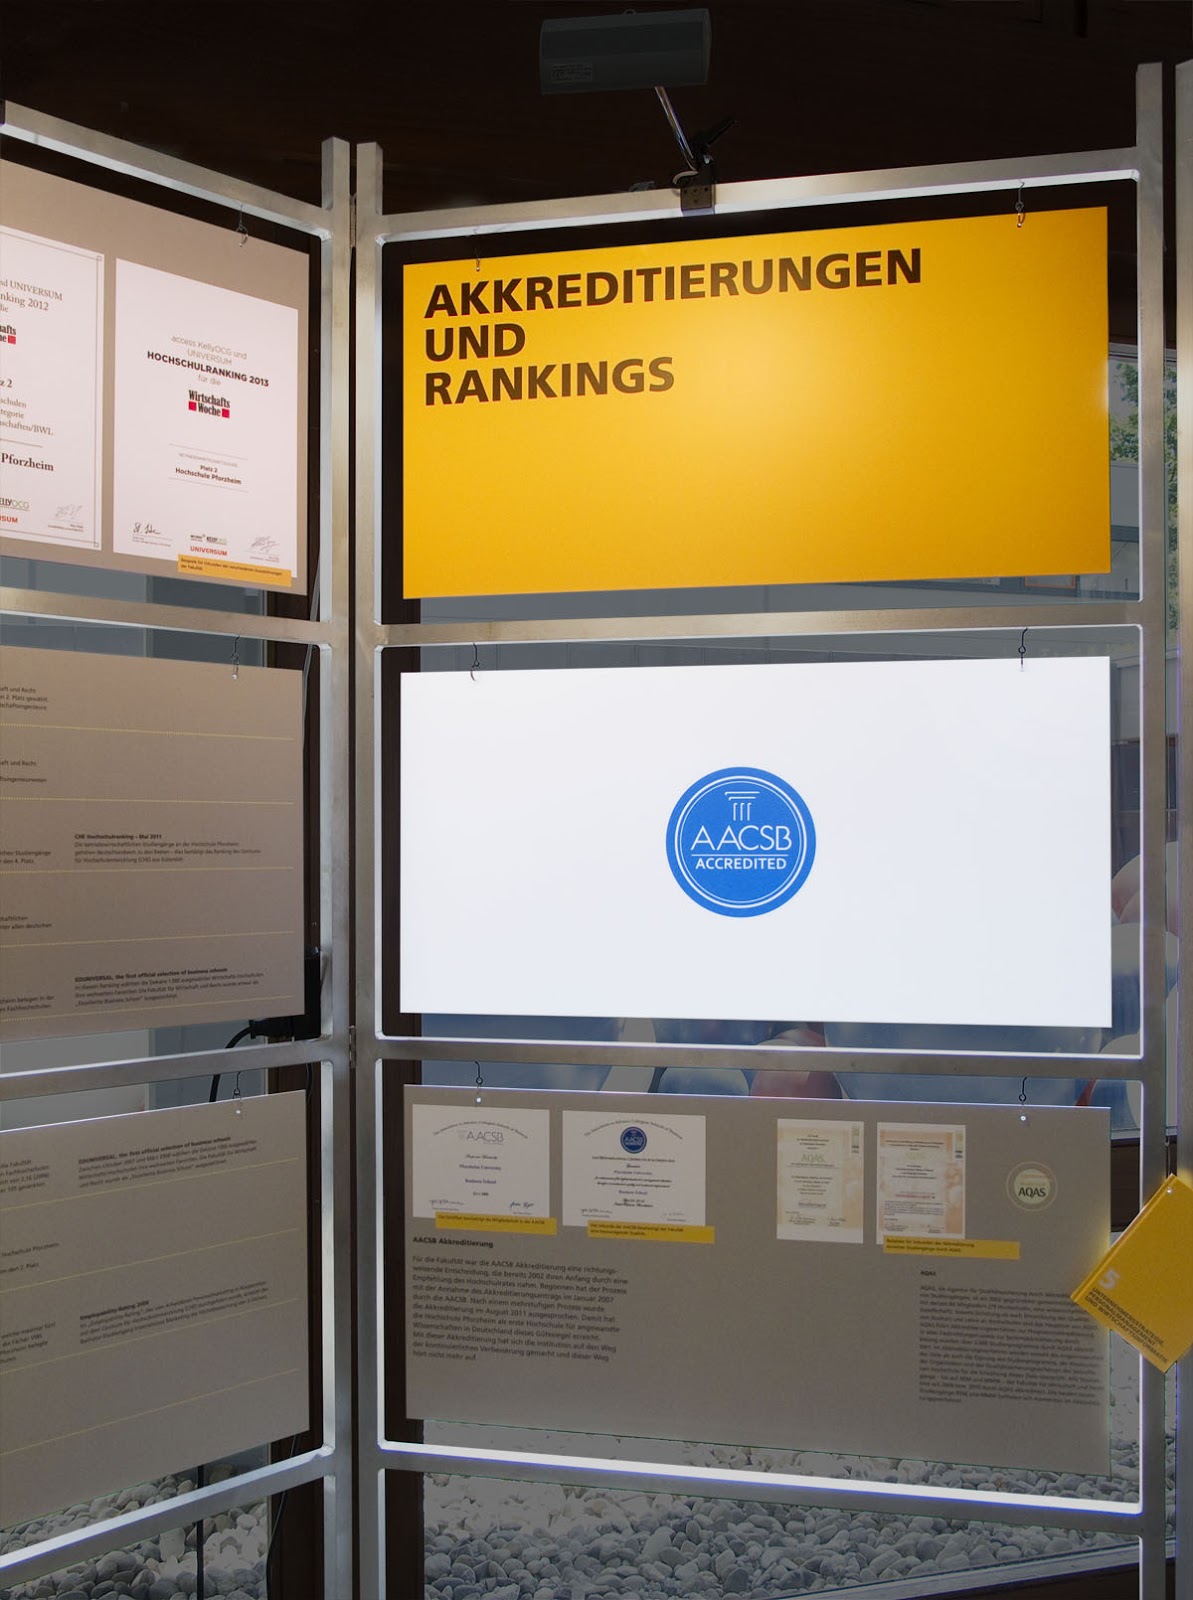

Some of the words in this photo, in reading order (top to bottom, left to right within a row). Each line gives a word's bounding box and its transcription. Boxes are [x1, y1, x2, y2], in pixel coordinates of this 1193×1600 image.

[10, 280, 63, 301] UNIVERSUM
[424, 248, 922, 318] AKKREDITIERUNGEN
[28, 298, 49, 311] 2012
[425, 323, 527, 362] UND
[187, 349, 233, 366] UNIVERSUM
[233, 351, 247, 360] und
[147, 350, 248, 382] HOCHSCHULRANKING
[249, 376, 269, 387] 2013
[425, 356, 675, 406] RANKINGS
[189, 390, 230, 408] Wirtschafts
[198, 402, 221, 417] Woche
[1, 453, 54, 471] Pforzheim
[176, 467, 210, 479] Hochschule
[211, 474, 242, 485] Pforzheim
[190, 546, 228, 556] UNIVERSUM
[690, 825, 792, 851] AACSB
[695, 858, 787, 870] ACCREDITED
[466, 1131, 504, 1143] AACSB
[1018, 1187, 1047, 1198] AQAS
[413, 1237, 437, 1245] AACSB
[439, 1237, 494, 1248] Akkreditierung
[413, 1265, 443, 1273] weisende
[445, 1267, 490, 1278] Entscheidung,
[504, 1270, 526, 1278] bereits
[565, 1274, 590, 1284] Anfang
[613, 1277, 628, 1285] eine
[437, 1256, 463, 1265] Fakultät
[491, 1260, 513, 1268] AACSB
[515, 1262, 566, 1273] Akkreditierung
[584, 1266, 618, 1276] richtungs-
[413, 1274, 452, 1285] Empfehlung
[466, 1278, 515, 1287] Hochschulrates
[540, 1282, 574, 1293] Begonnen
[588, 1285, 600, 1293] der
[602, 1286, 627, 1294] Prozess
[438, 1285, 469, 1294] Annahme
[484, 1288, 562, 1301] Akkreditierungsantrags
[574, 1294, 596, 1302] Januar
[425, 1304, 474, 1315] Akkreditierung
[486, 1308, 509, 1317] August
[511, 1309, 526, 1317] 2011
[528, 1311, 578, 1322] ausgesprochen.
[470, 1297, 487, 1305] Nach
[489, 1298, 509, 1306] einem
[511, 1300, 555, 1311] mehrstufigen
[557, 1303, 581, 1311] Prozess
[583, 1304, 605, 1312] wurde
[413, 1322, 462, 1331] Wissenschaften
[472, 1326, 513, 1335] Deutschland
[514, 1328, 534, 1336] dieses
[536, 1330, 571, 1340] Gütesiegel
[572, 1332, 599, 1340] erreicht.
[425, 1313, 461, 1322] Hochschule
[463, 1315, 496, 1324] Pforzheim
[526, 1320, 564, 1329] Hochschule
[577, 1323, 621, 1334] angewandte
[426, 1332, 445, 1340] dieser
[446, 1334, 496, 1345] Akkreditierung
[537, 1340, 571, 1348] Institution
[601, 1344, 617, 1353] Weg
[425, 1342, 478, 1352] kontinuierlichen
[480, 1346, 525, 1357] Verbesserung
[526, 1349, 555, 1359] gemacht
[571, 1352, 592, 1360] dieser
[593, 1354, 609, 1363] Weg
